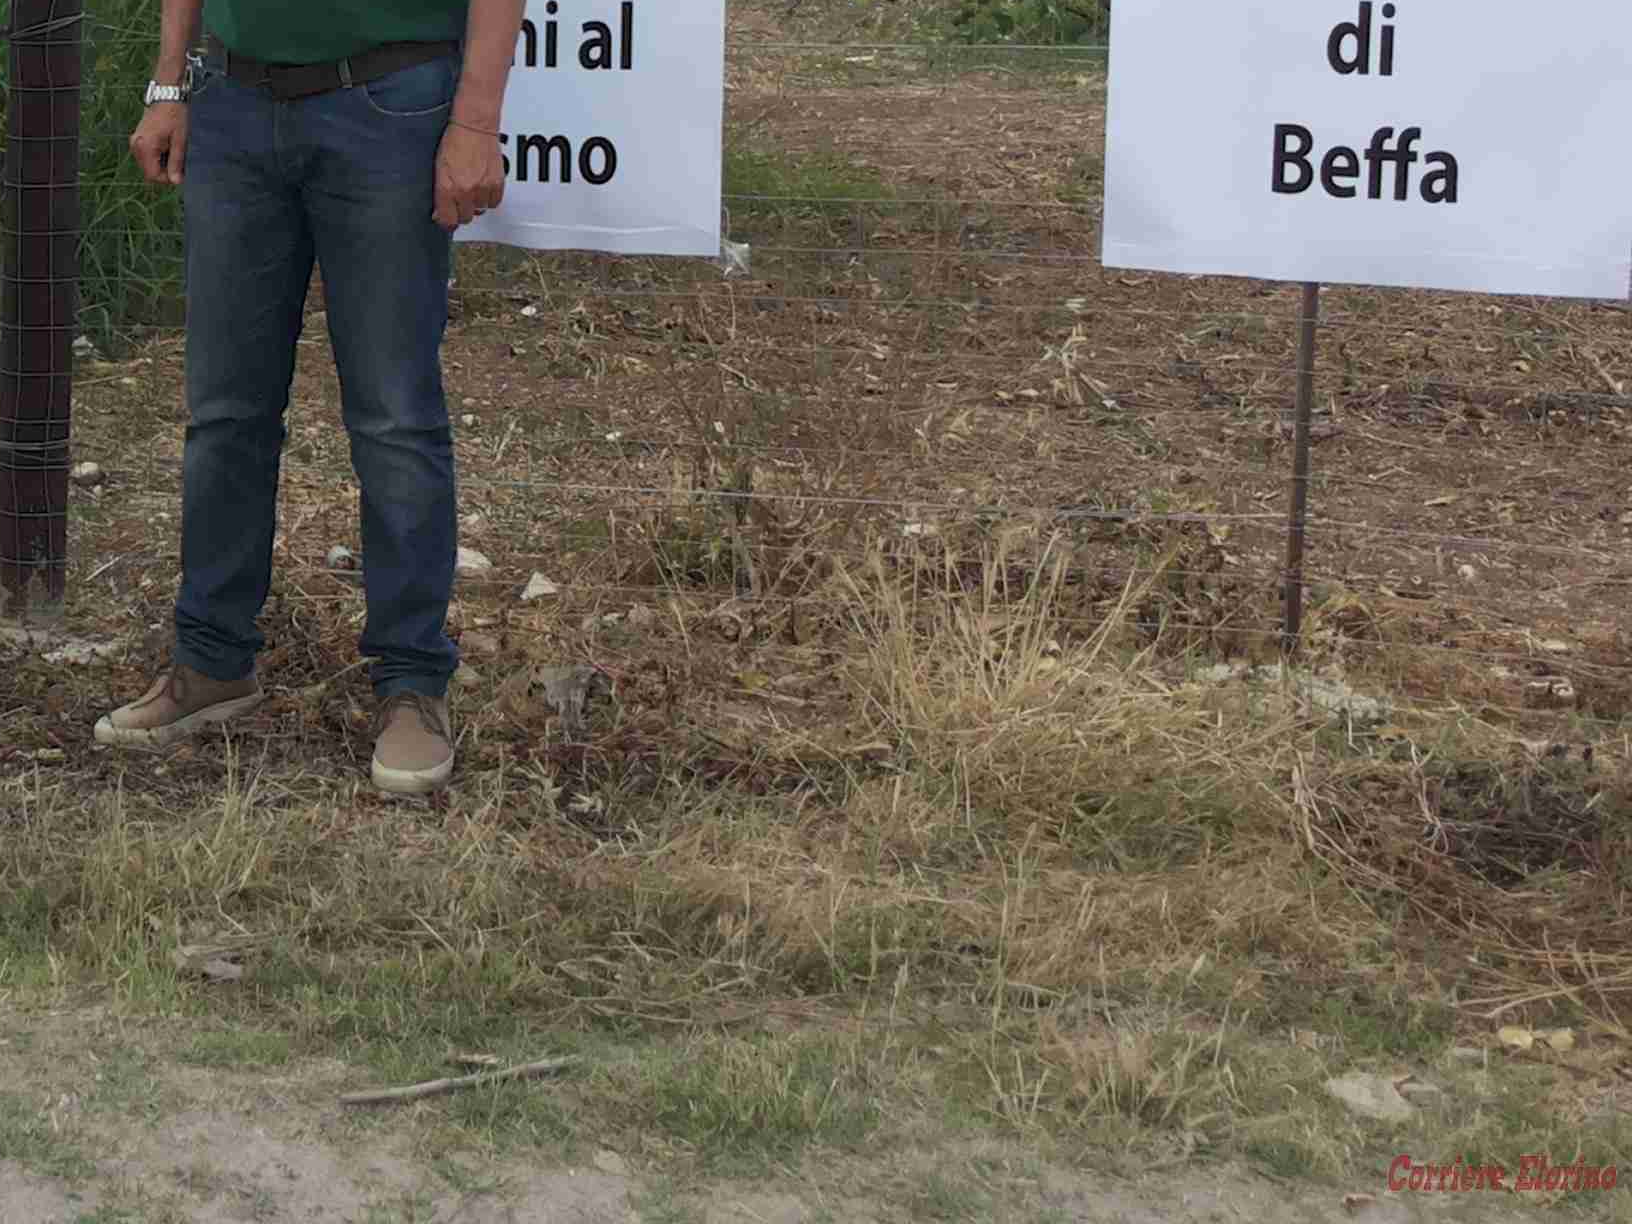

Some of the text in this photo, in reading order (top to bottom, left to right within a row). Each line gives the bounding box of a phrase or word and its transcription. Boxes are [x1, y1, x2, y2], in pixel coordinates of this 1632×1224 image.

[577, 0, 634, 71] al
[1327, 0, 1396, 77] di
[1271, 123, 1459, 204] Beffa
